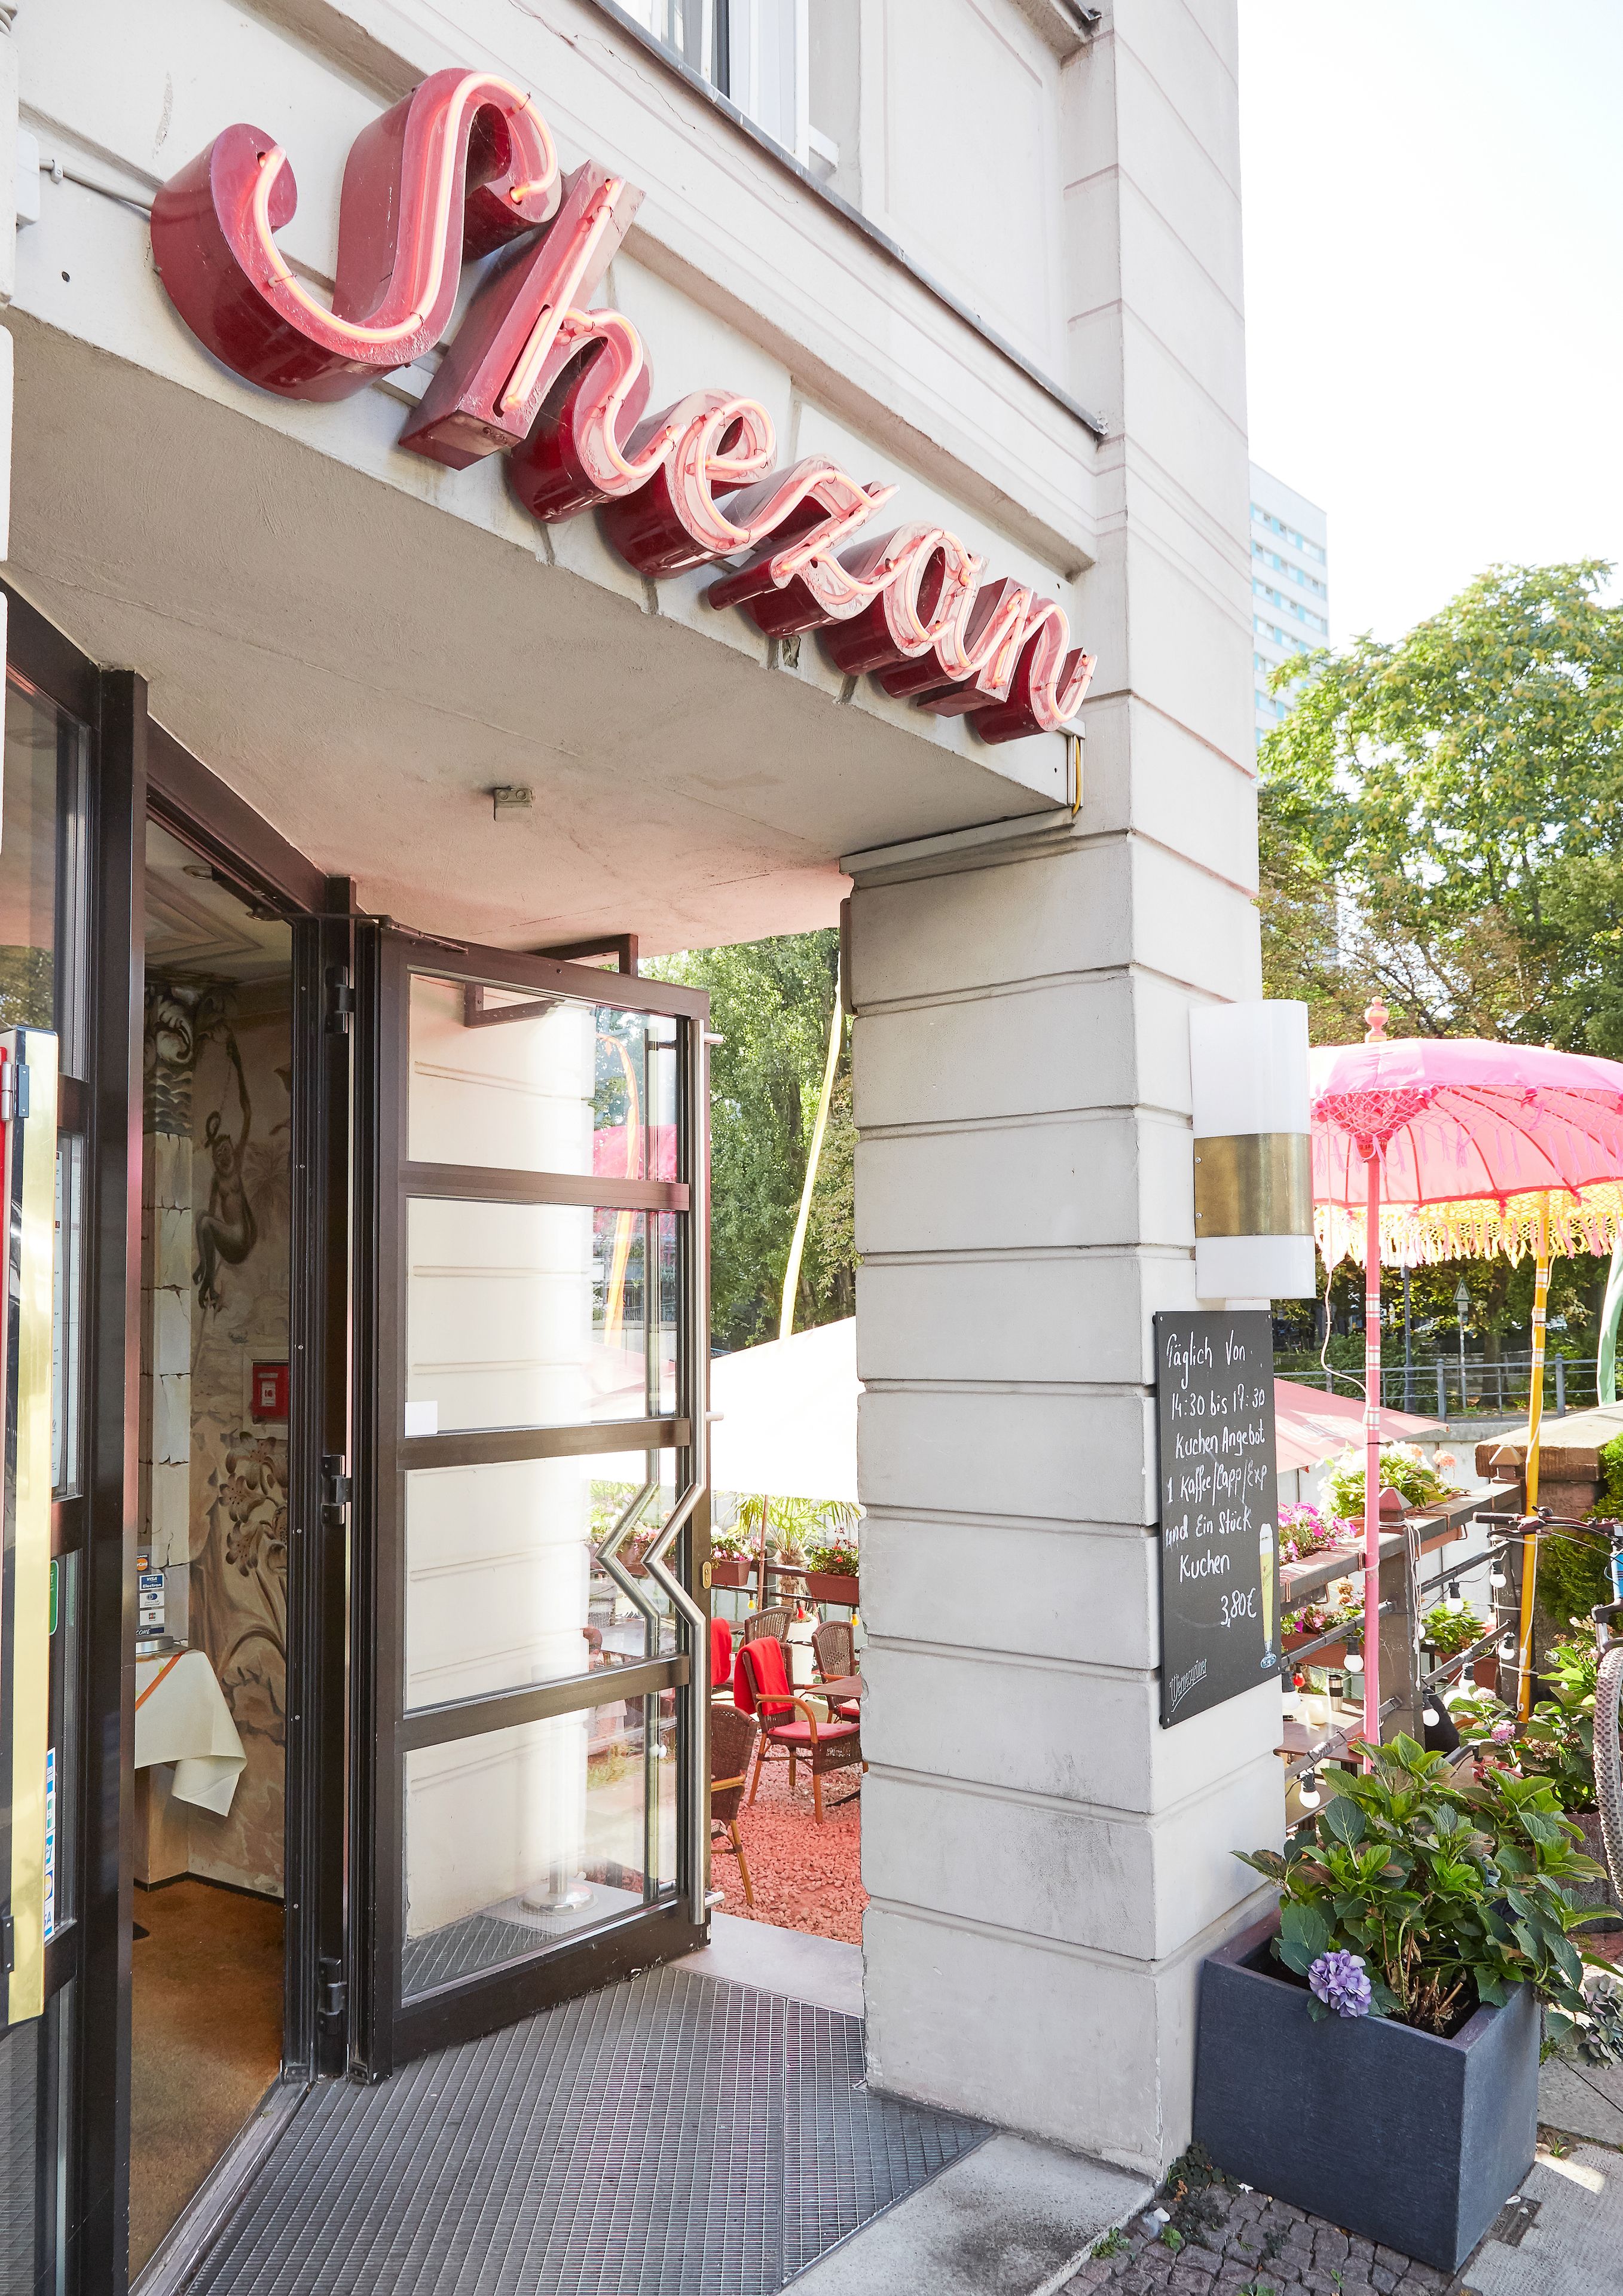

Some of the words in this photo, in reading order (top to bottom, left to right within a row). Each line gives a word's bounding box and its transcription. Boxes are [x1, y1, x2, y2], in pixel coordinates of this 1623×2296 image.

[151, 68, 1098, 746] Shezan
[1166, 1330, 1213, 1390] Täglich
[1225, 1329, 1246, 1366] Von
[1171, 1392, 1205, 1420] 14:30
[1209, 1389, 1228, 1416] bis
[1175, 1428, 1218, 1460] Kuchen
[1221, 1418, 1266, 1457] Angebot
[1166, 1476, 1173, 1504] 1
[1166, 1514, 1188, 1547] und
[1195, 1513, 1214, 1538] Ein
[1218, 1505, 1252, 1535] Stück
[1179, 1549, 1230, 1583] Kuchen
[1220, 1587, 1257, 1629] 3,80€
